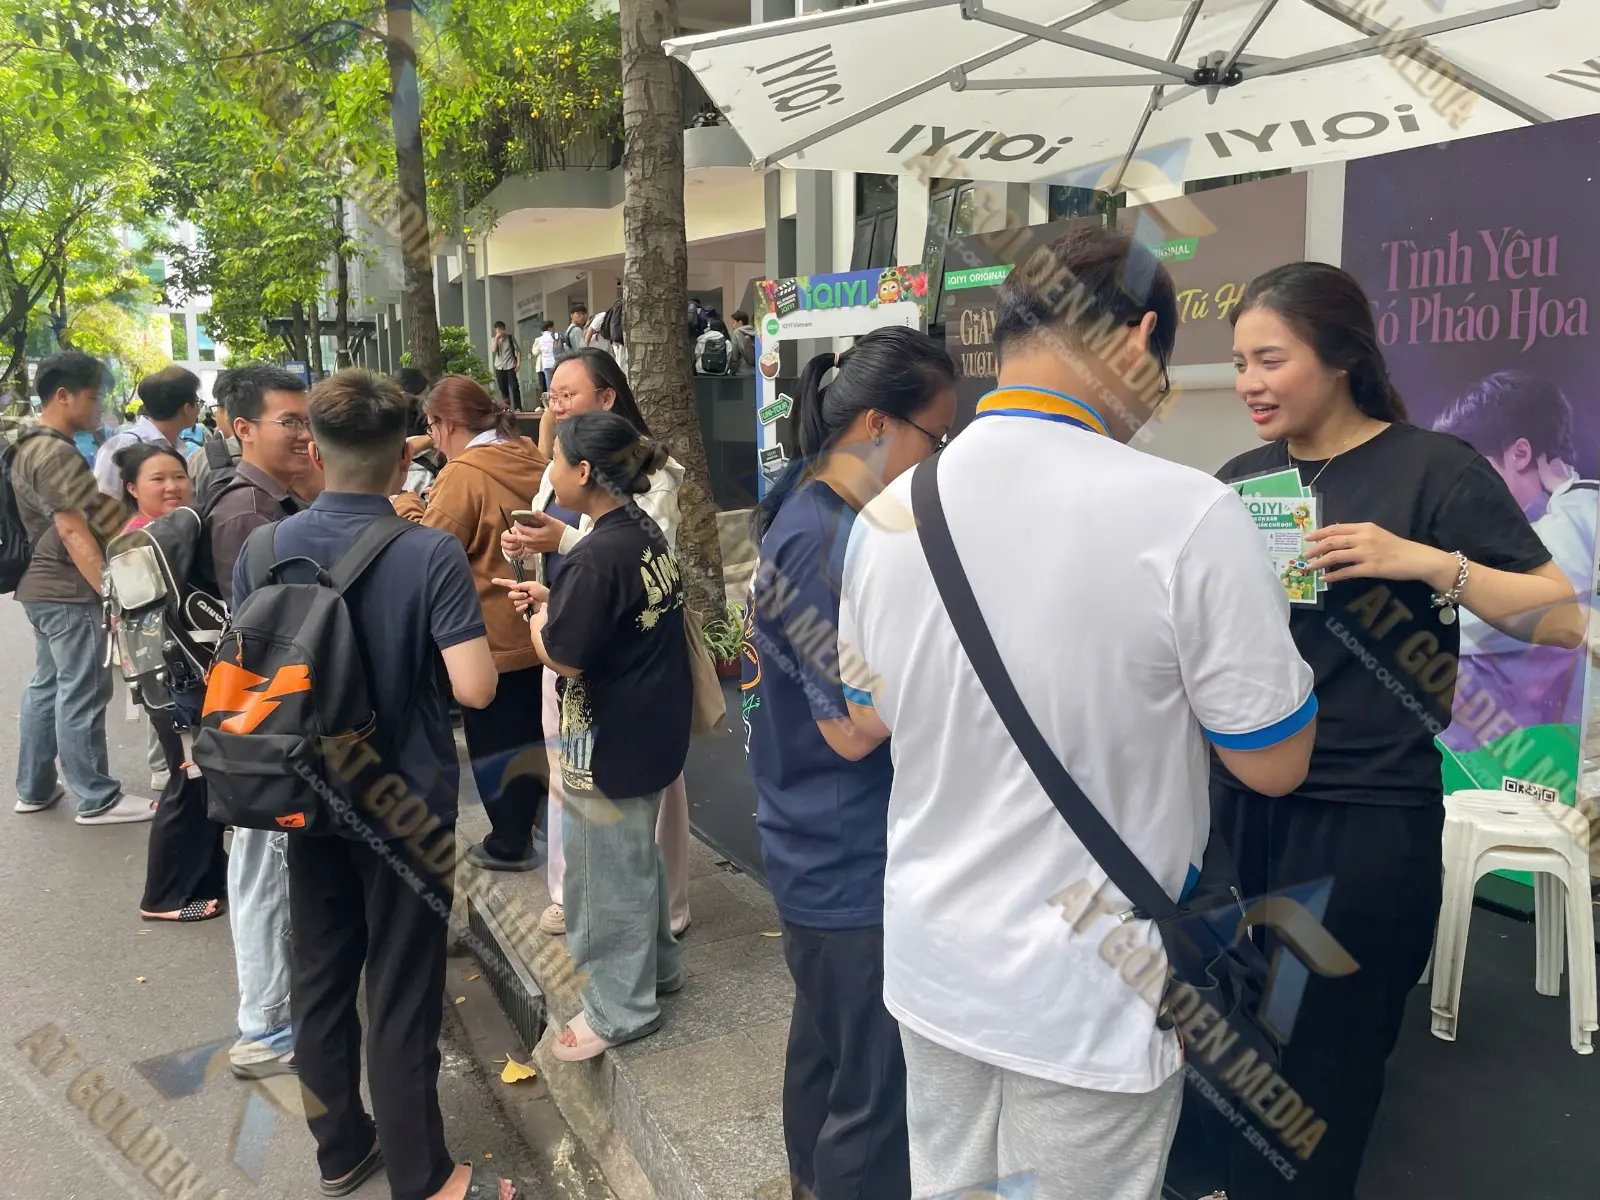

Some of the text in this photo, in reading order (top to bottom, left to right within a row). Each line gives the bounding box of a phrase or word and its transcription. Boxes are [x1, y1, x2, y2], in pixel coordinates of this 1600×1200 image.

[1151, 244, 1190, 258] RIGINAL
[1381, 226, 1559, 292] Tình Yêu
[970, 271, 1007, 282] ORIGINAL
[806, 279, 869, 311] iQIYI
[1176, 289, 1209, 323] Tú
[1407, 291, 1500, 345] Pháo
[1507, 287, 1589, 353] Hoa
